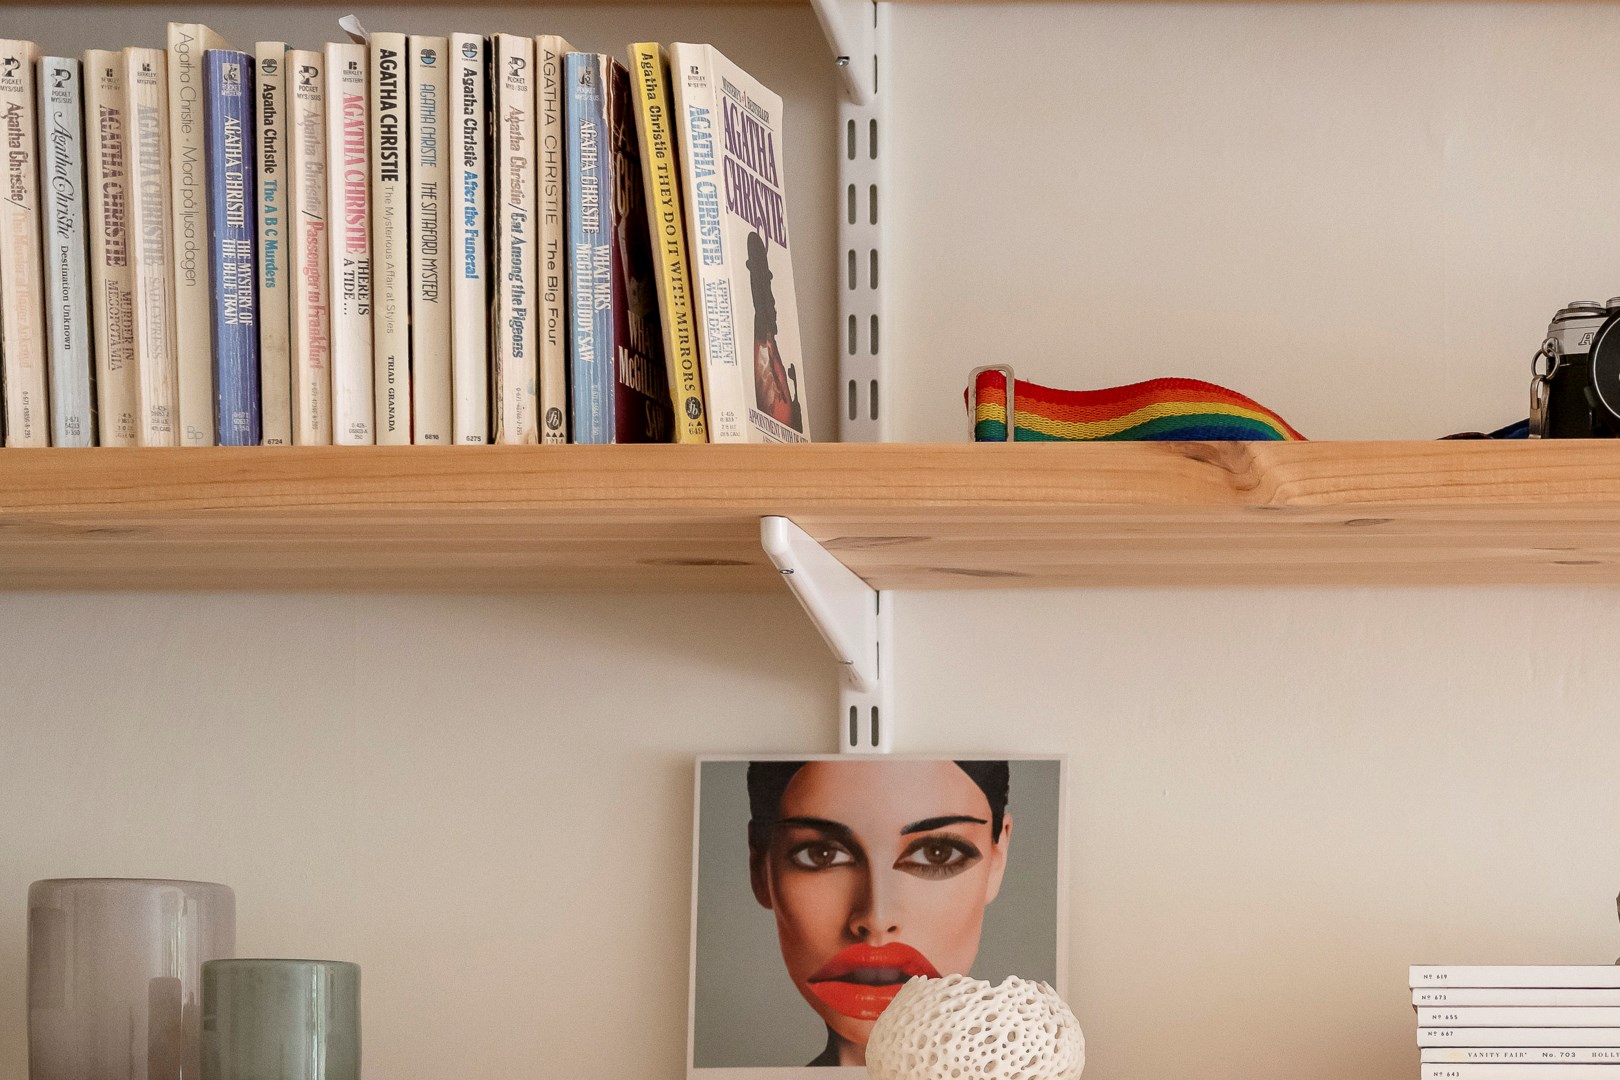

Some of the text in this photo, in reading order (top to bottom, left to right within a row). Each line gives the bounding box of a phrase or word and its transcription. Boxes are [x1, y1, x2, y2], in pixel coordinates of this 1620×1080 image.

[261, 83, 276, 126] Agatha
[420, 84, 436, 125] AGATHA
[100, 104, 123, 178] AGATHA
[224, 116, 242, 167] AGATHA
[264, 129, 278, 174] Christie
[420, 127, 437, 167] CHRISTIE
[689, 104, 716, 179] AGATHA
[723, 96, 779, 188] AGATHA
[226, 172, 244, 229] CHRISTIE
[264, 179, 278, 202] The
[343, 92, 367, 254] AGATHA CHRISTIE
[380, 49, 399, 334] AGATHA CHRISTIE The Mysterious Affair at Styles
[421, 182, 437, 200] THE
[462, 67, 479, 279] Agatha Christie After the Funeral
[543, 49, 559, 345] AGATHA CHRISTIE The Big Four
[723, 155, 787, 252] CHRISTIE
[103, 182, 127, 266] CHRISTIE
[265, 204, 278, 213] A
[265, 217, 278, 226] B
[421, 202, 438, 254] SITTAFORD
[641, 53, 695, 391] Agatha Christie THEY DO IT WITH MIRRORS
[695, 181, 723, 266] CHRISTIE
[222, 239, 238, 325] THE BLUE TRAIN
[265, 241, 278, 288] Murders
[357, 258, 370, 316] THERE IS
[422, 258, 439, 304] MYSTERY
[594, 245, 611, 313] WHAT MRS.
[387, 355, 396, 432] TRIAD GRANADA
